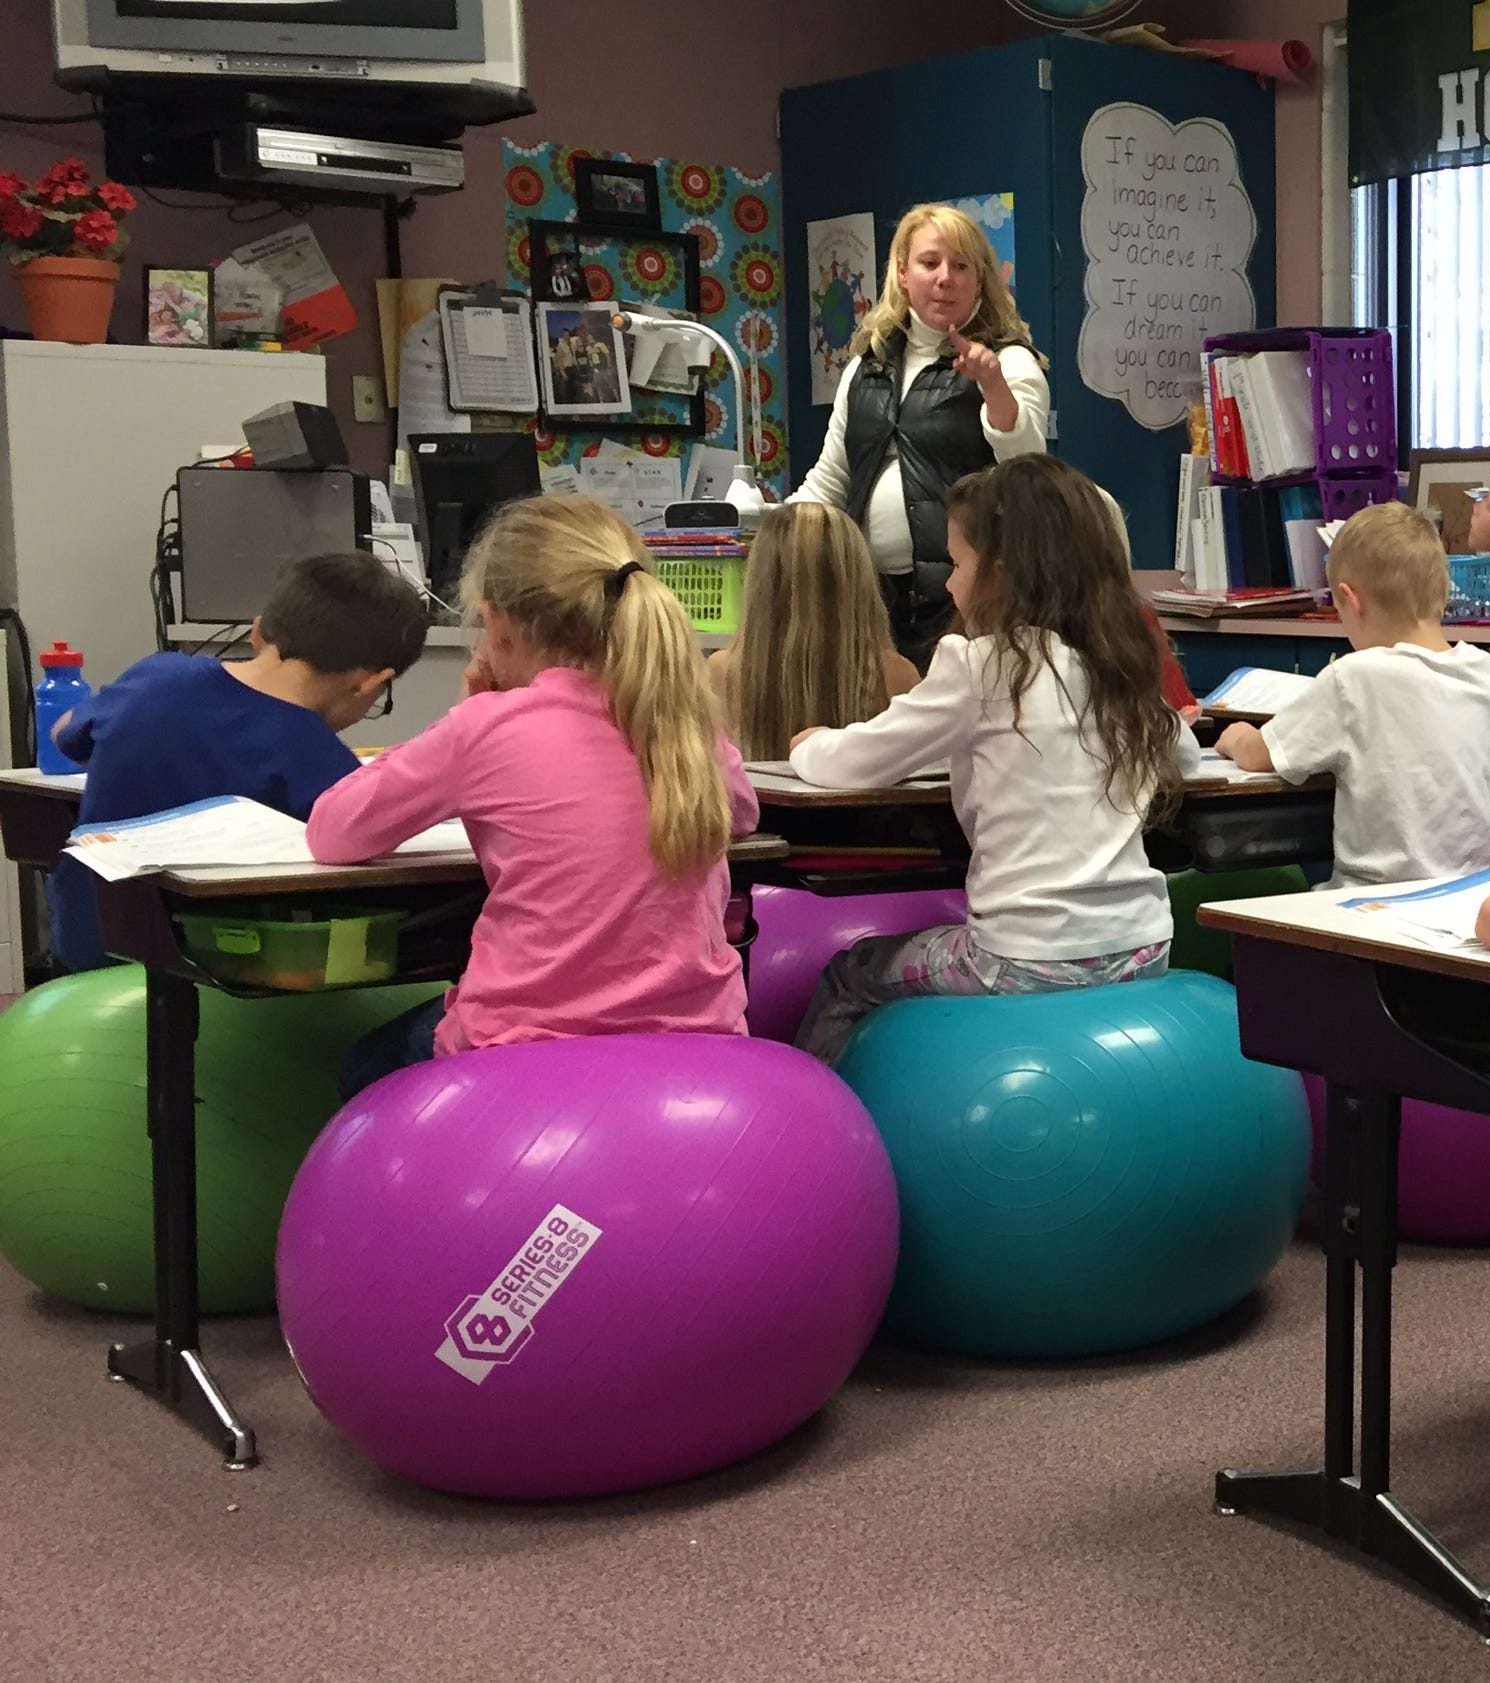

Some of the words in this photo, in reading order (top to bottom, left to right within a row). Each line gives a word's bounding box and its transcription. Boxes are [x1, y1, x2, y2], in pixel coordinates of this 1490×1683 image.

[1105, 136, 1135, 164] If
[1142, 152, 1175, 181] you
[1184, 154, 1219, 173] can
[1198, 185, 1216, 219] it,
[1108, 220, 1140, 252] you
[1148, 222, 1179, 240] can
[1126, 244, 1196, 268] achieve
[1112, 278, 1138, 306] If
[1145, 293, 1184, 323] you
[1189, 293, 1222, 312] can
[1124, 316, 1182, 340] dream
[1115, 348, 1147, 376] you
[1156, 350, 1190, 368] can
[508, 1228, 589, 1320] FITNESS
